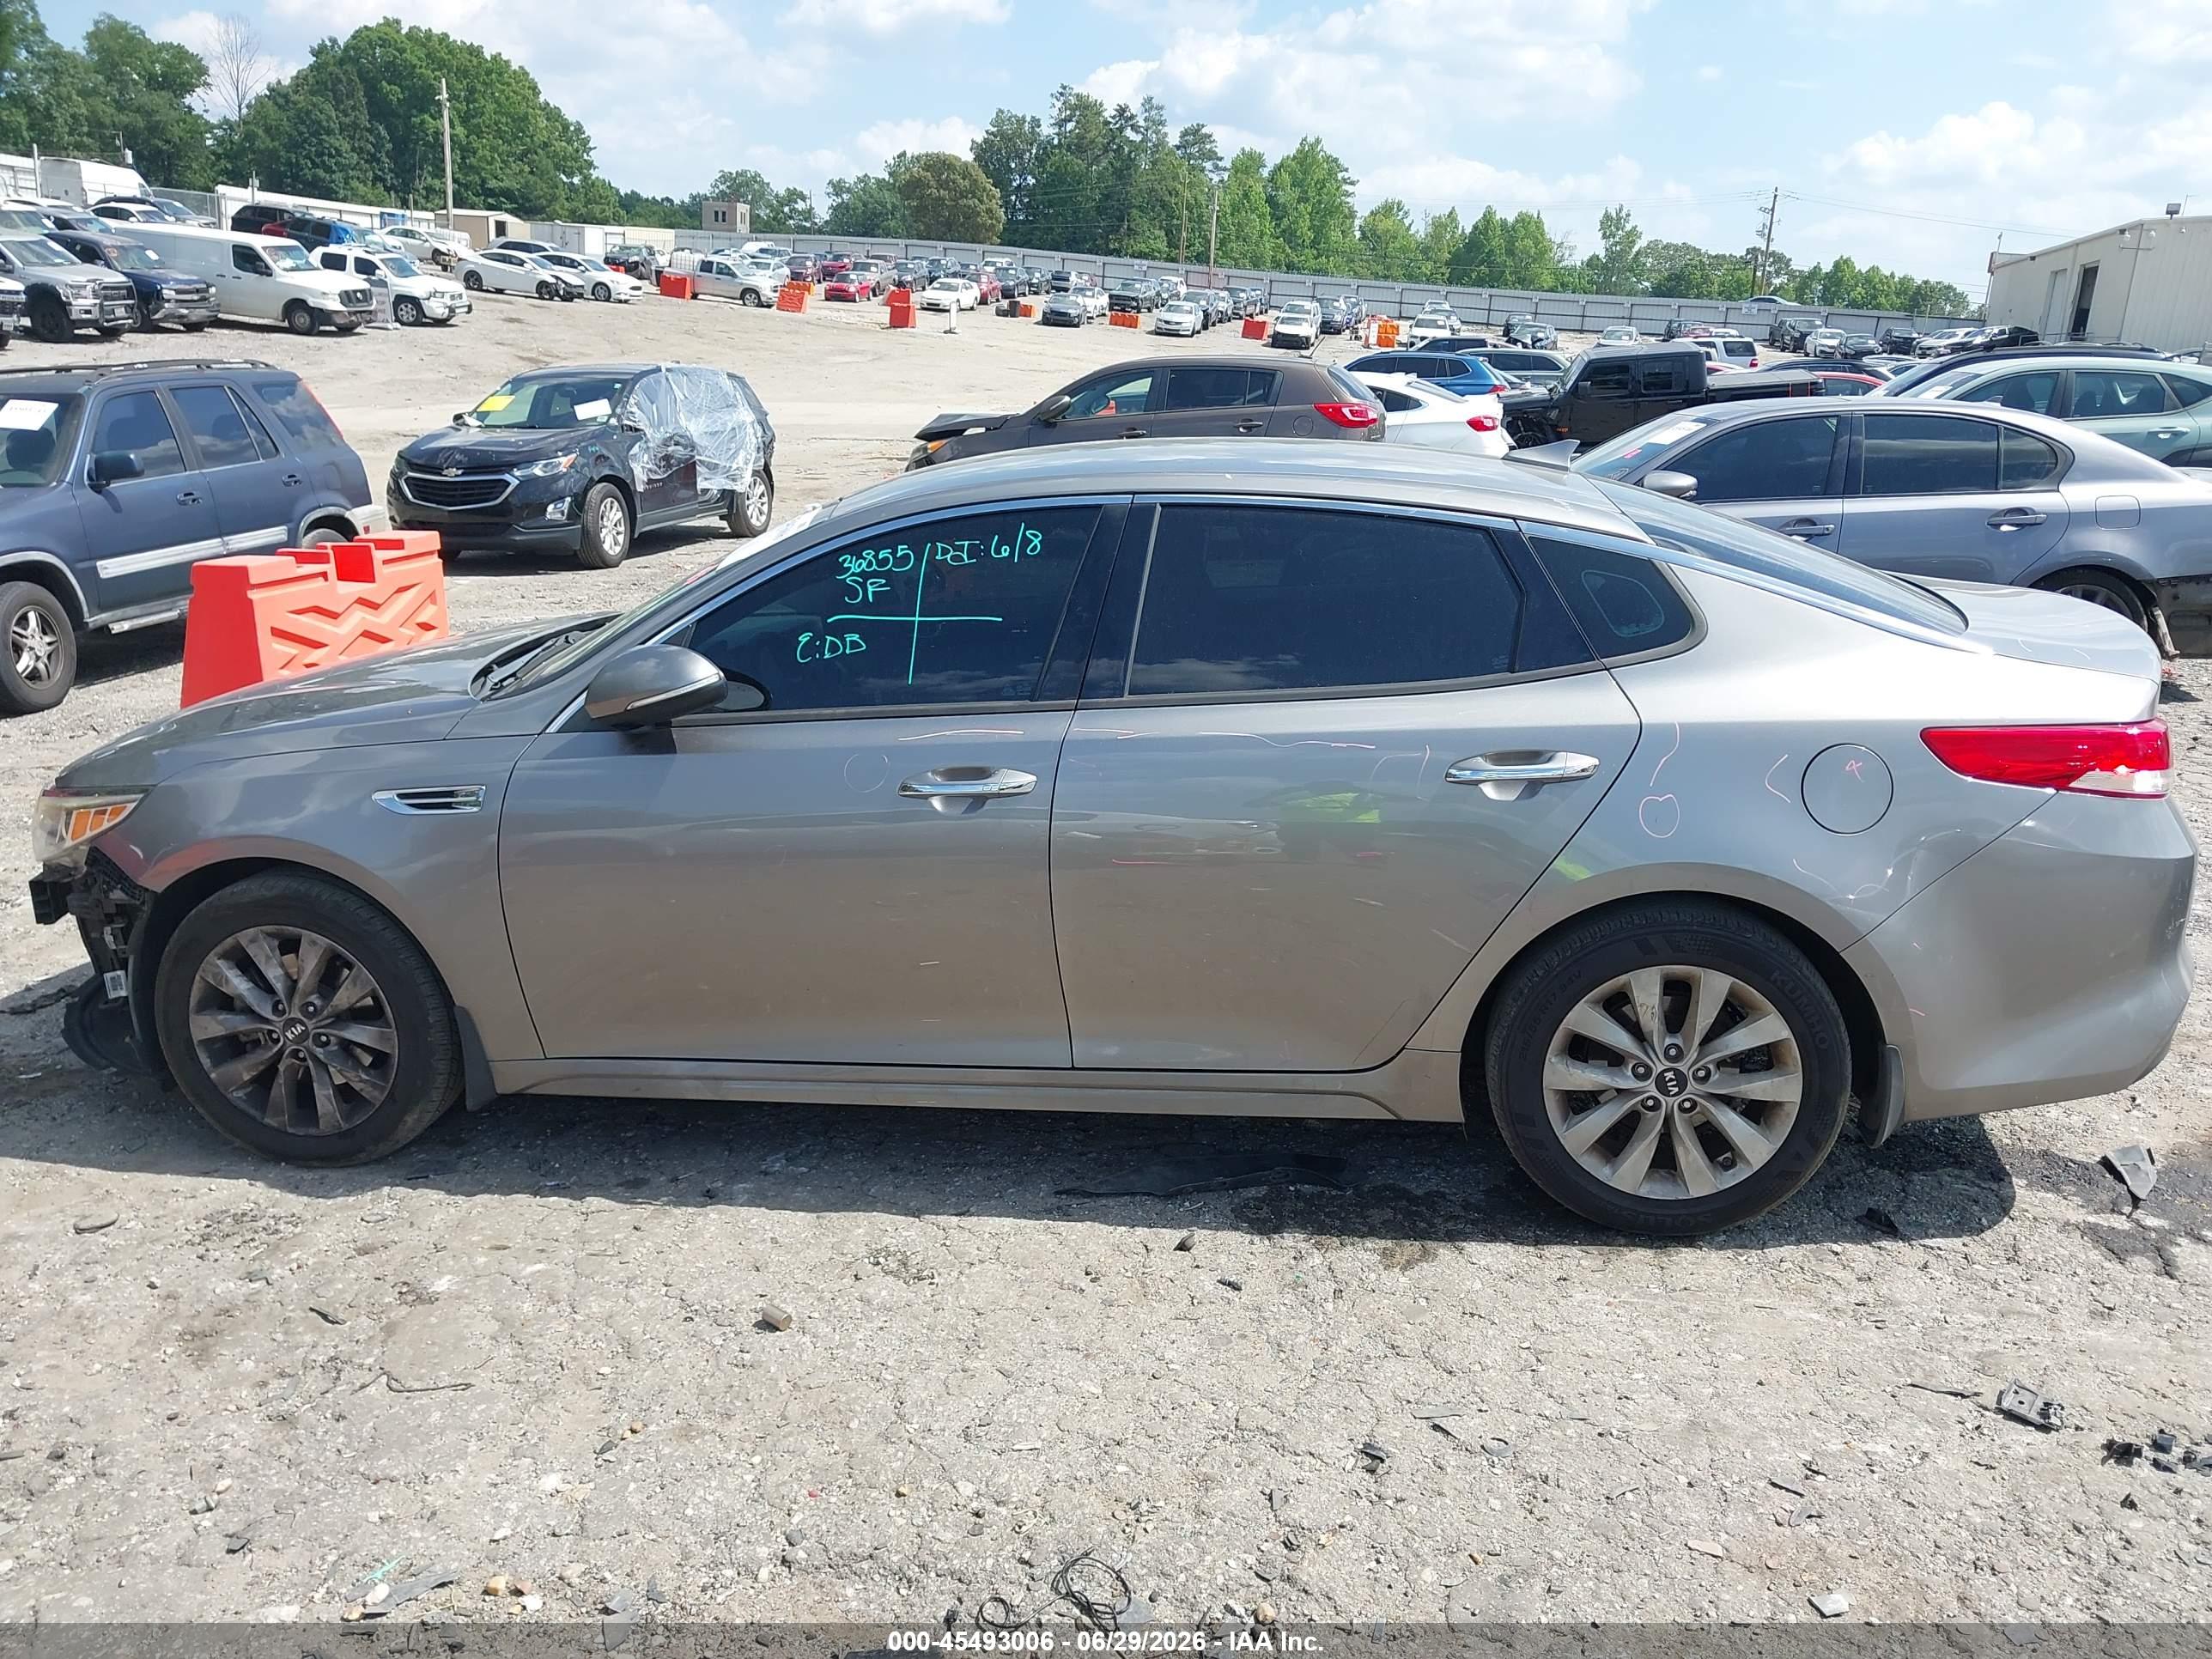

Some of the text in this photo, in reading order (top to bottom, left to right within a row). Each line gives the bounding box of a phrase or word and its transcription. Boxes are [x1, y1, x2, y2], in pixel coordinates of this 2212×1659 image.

[836, 544, 915, 580] 36855
[1770, 969, 1831, 1049] KUMHO
[284, 1023, 306, 1040] KIA
[1663, 1070, 1679, 1096] KIA
